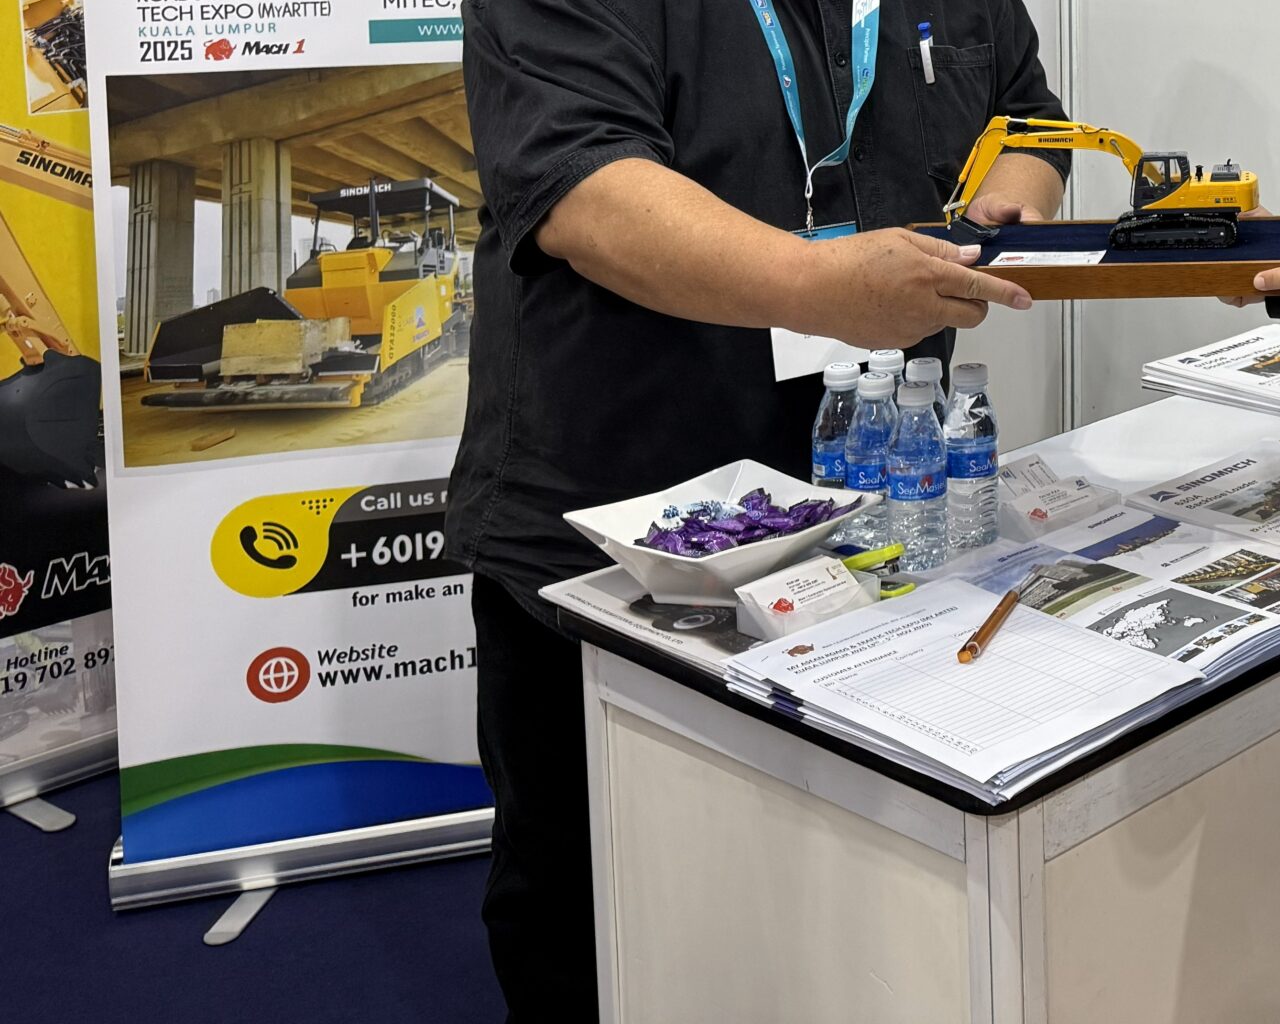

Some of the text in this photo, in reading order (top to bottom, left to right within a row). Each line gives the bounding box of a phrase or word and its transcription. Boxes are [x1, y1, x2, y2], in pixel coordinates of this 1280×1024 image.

[137, 5, 193, 22] TECH
[200, 3, 254, 20] EXPO
[138, 23, 276, 37] KUALA LUMPUR
[140, 40, 192, 62] 2025
[292, 39, 305, 54] 1
[340, 183, 391, 198] SINOMCH
[1176, 459, 1257, 491] SINOMACH
[361, 491, 434, 512] Call us
[341, 531, 445, 568] +6019
[352, 583, 464, 607] for make an
[6, 645, 69, 671] Hotline
[317, 644, 398, 666] Website
[36, 657, 76, 684] 702
